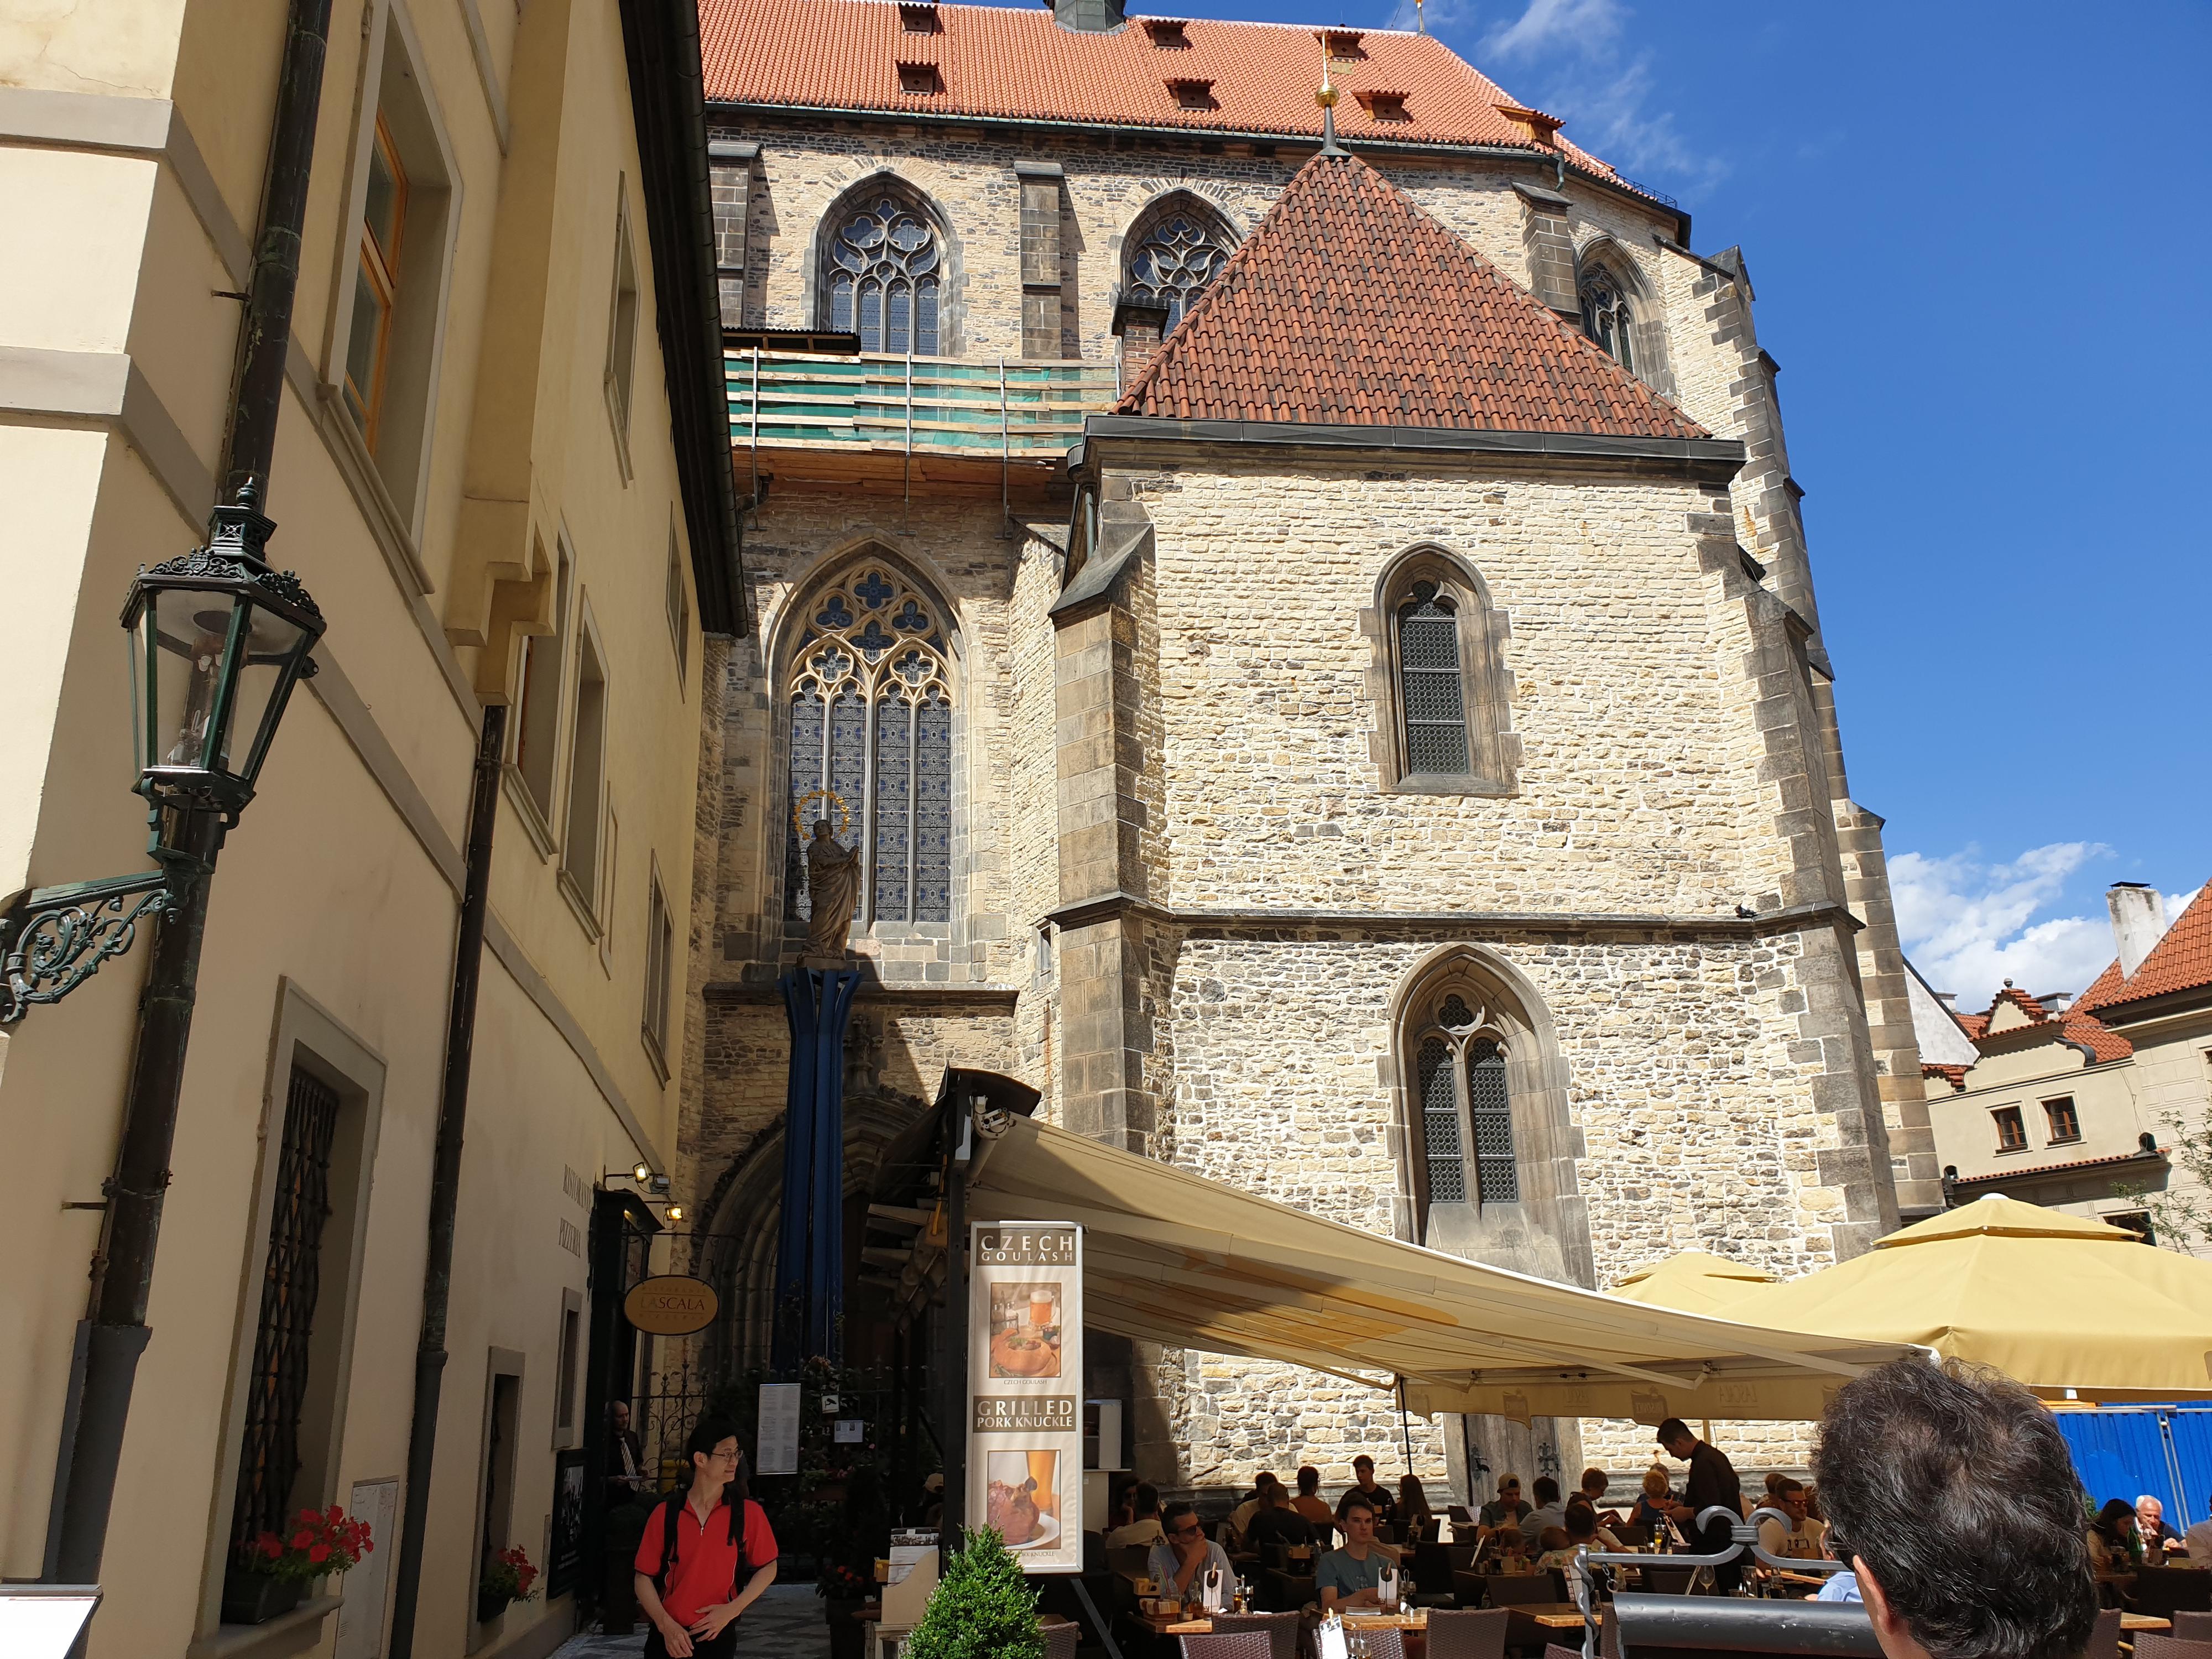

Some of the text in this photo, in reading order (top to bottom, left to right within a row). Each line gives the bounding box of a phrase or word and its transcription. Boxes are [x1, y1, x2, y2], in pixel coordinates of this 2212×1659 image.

[981, 1235, 1073, 1251] CZECH
[981, 1251, 1073, 1261] GOULASH
[977, 1400, 1073, 1416] GRILLED
[977, 1416, 1073, 1427] PORK KNUCKLE
